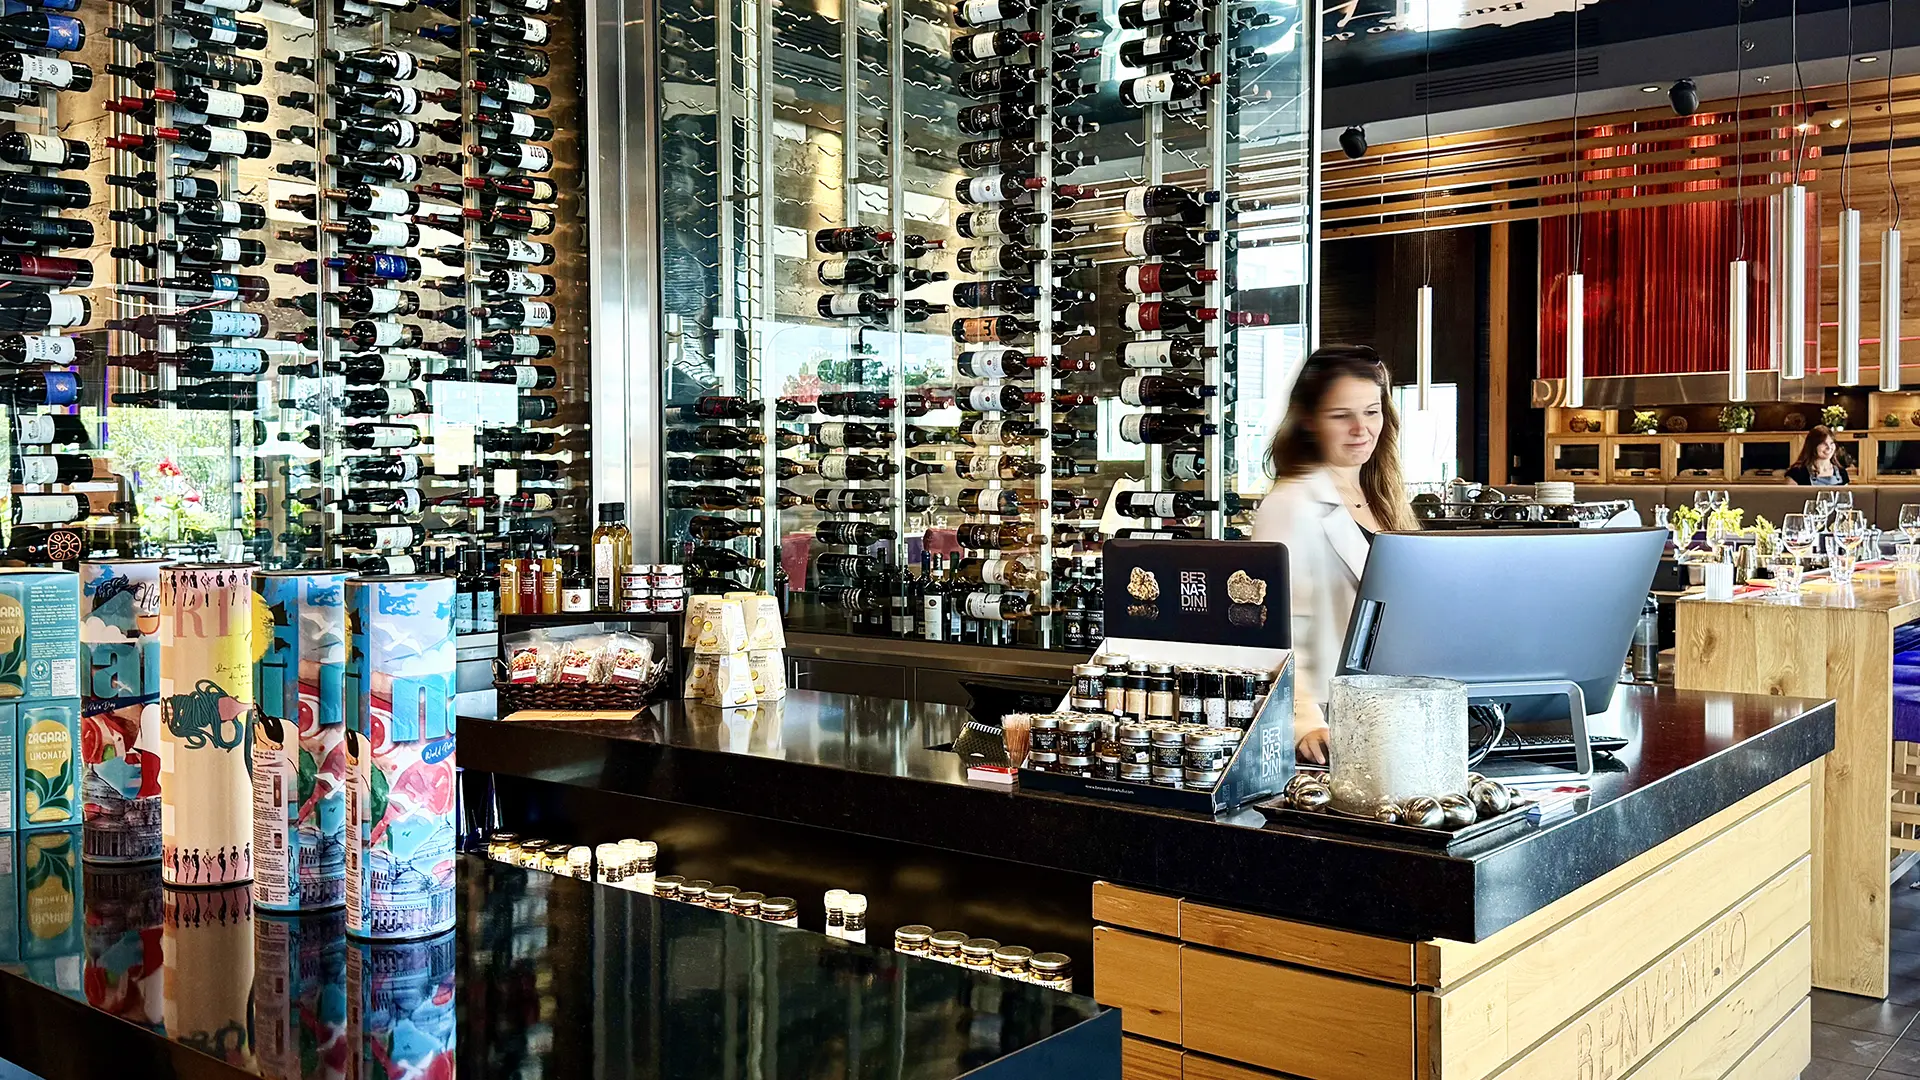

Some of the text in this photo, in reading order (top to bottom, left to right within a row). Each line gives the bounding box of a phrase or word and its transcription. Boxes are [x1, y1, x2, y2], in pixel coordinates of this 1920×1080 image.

[1180, 571, 1206, 584] BER
[1180, 583, 1207, 596] NAR
[1181, 595, 1207, 608] DINI
[172, 585, 251, 639] RI
[28, 731, 68, 745] ZAGARA
[1262, 727, 1281, 746] BER
[29, 750, 67, 761] LIMONATA
[1262, 742, 1281, 762] NAR
[1262, 758, 1281, 778] DINI
[1577, 911, 1748, 1080] BENVENUTO
